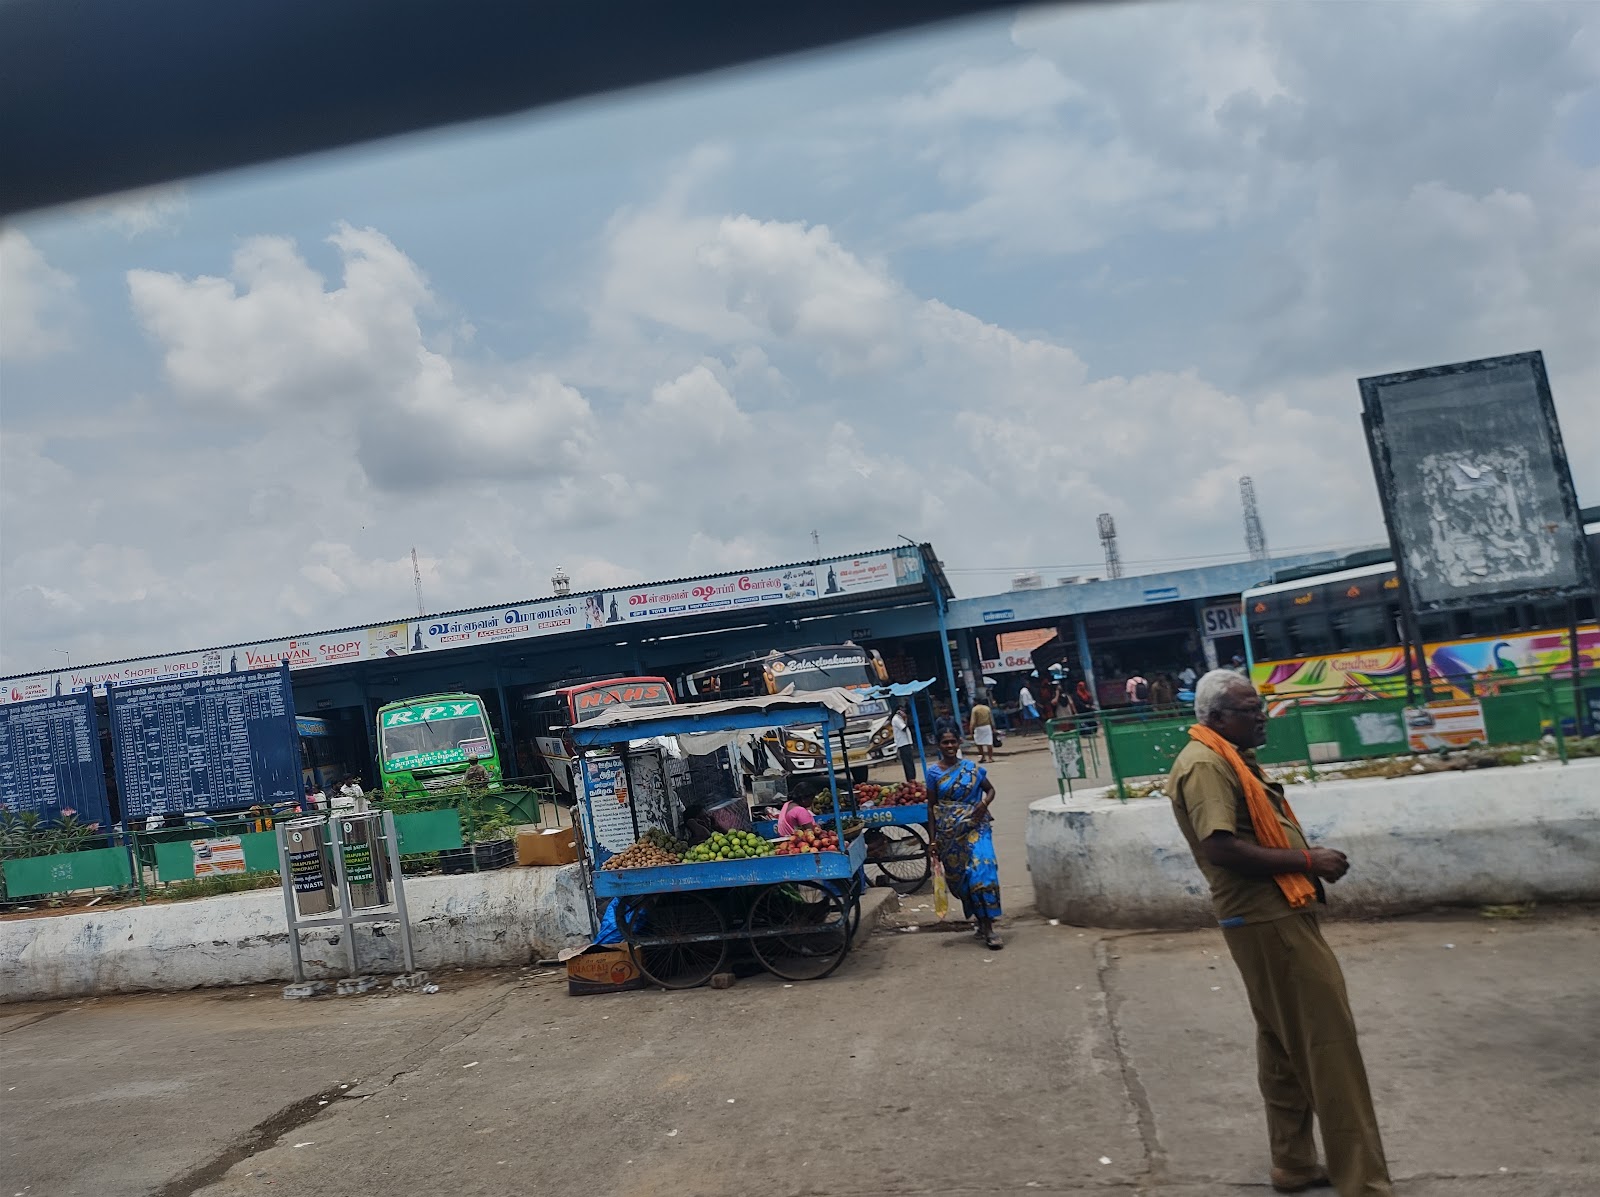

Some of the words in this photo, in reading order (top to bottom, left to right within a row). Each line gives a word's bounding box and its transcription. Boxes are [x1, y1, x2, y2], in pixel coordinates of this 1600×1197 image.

[628, 589, 689, 606] வள்ளுவன்
[429, 616, 500, 635] வள்ளுவன்
[504, 604, 578, 624] மொபைல்ஸ்
[478, 625, 528, 637] ACCESSORIES
[539, 619, 570, 629] SERVICE
[245, 646, 310, 665] VALLUVAN
[319, 641, 362, 655] SHOPY
[124, 667, 159, 679] SHOPIE
[164, 661, 199, 673] WORLD
[580, 685, 661, 708] NAHS
[303, 880, 324, 890] WASTE
[354, 873, 373, 881] WASTE
